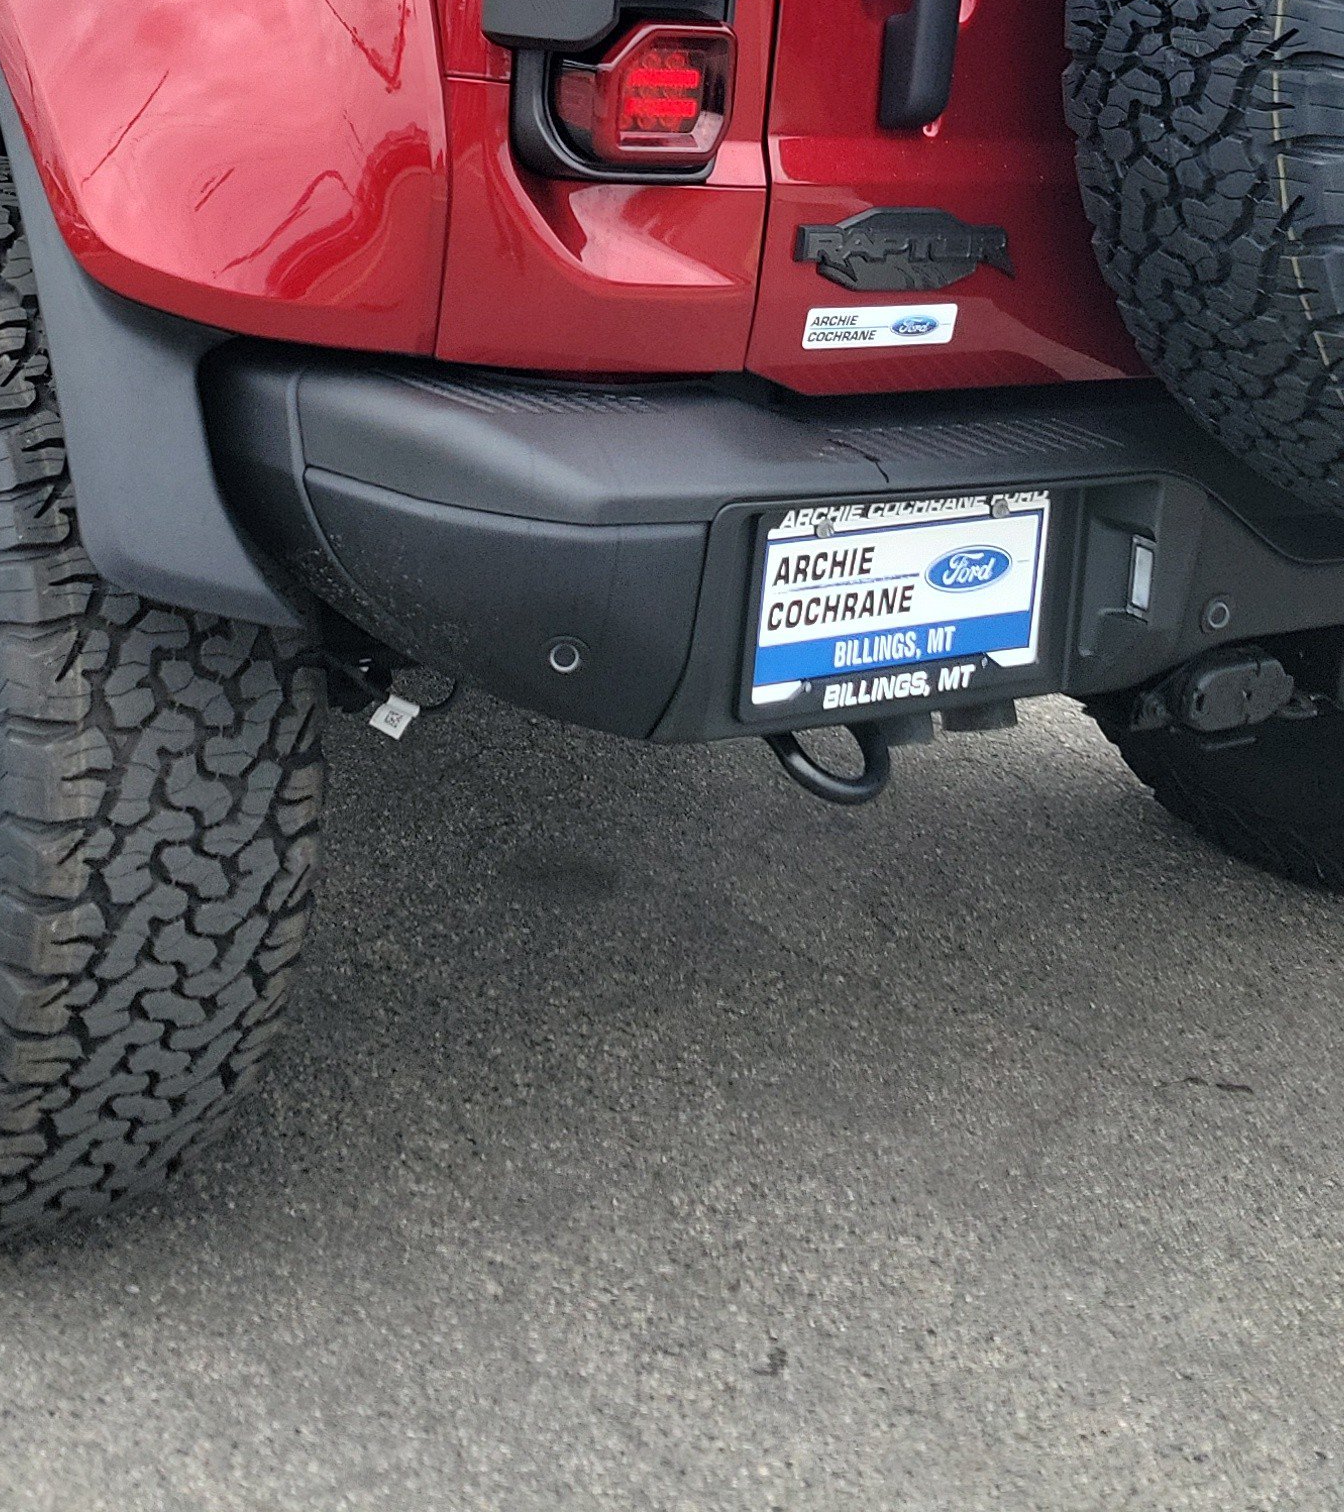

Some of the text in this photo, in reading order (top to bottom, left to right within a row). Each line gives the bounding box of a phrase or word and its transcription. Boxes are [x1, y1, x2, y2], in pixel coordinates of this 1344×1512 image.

[804, 227, 1016, 280] RAPTOR
[807, 330, 876, 343] COCHRANE
[810, 315, 859, 328] ARCHIE
[779, 504, 864, 529] ARCHIE
[772, 546, 875, 587] ARCHIE
[942, 552, 996, 585] Ford
[767, 584, 914, 631] COCHRANE
[834, 626, 956, 668] BILLINGS, MT
[823, 664, 976, 709] BILLINGS, MT
